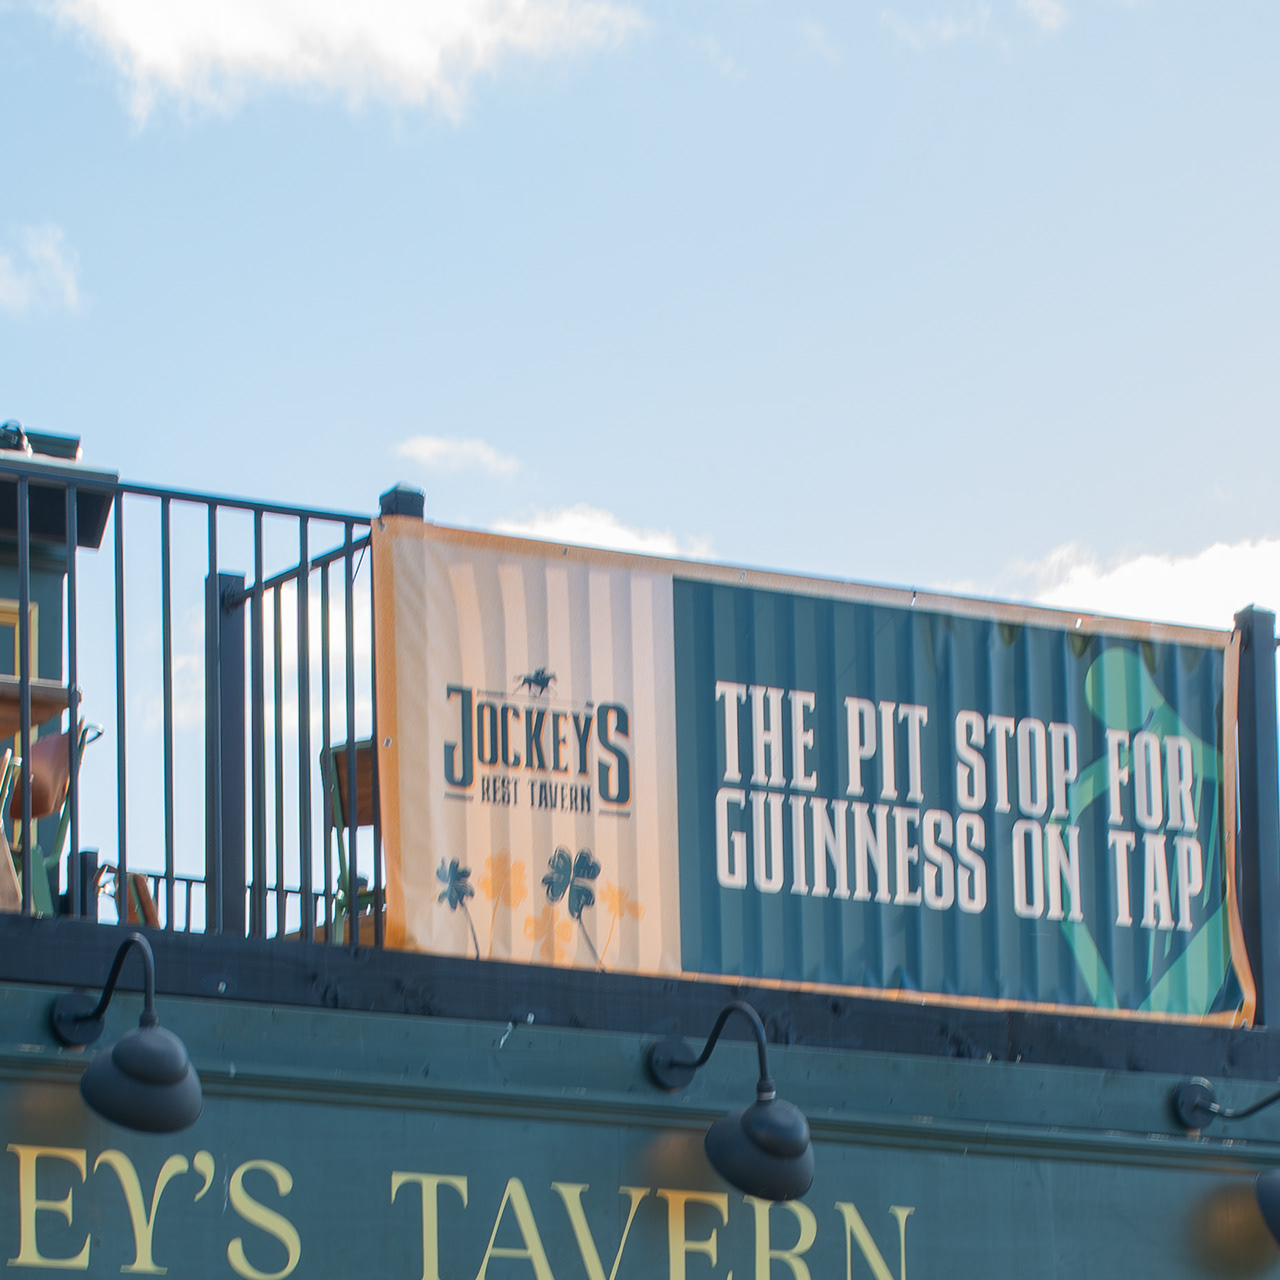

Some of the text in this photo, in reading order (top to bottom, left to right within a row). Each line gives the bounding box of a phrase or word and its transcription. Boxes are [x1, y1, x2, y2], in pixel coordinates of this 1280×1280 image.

[444, 684, 631, 804] JOCKEY'S
[480, 775, 592, 814] REST TAVERN
[715, 681, 1197, 832] THE PIT STOP FOR
[717, 788, 1204, 932] GUINNESS ON TAP
